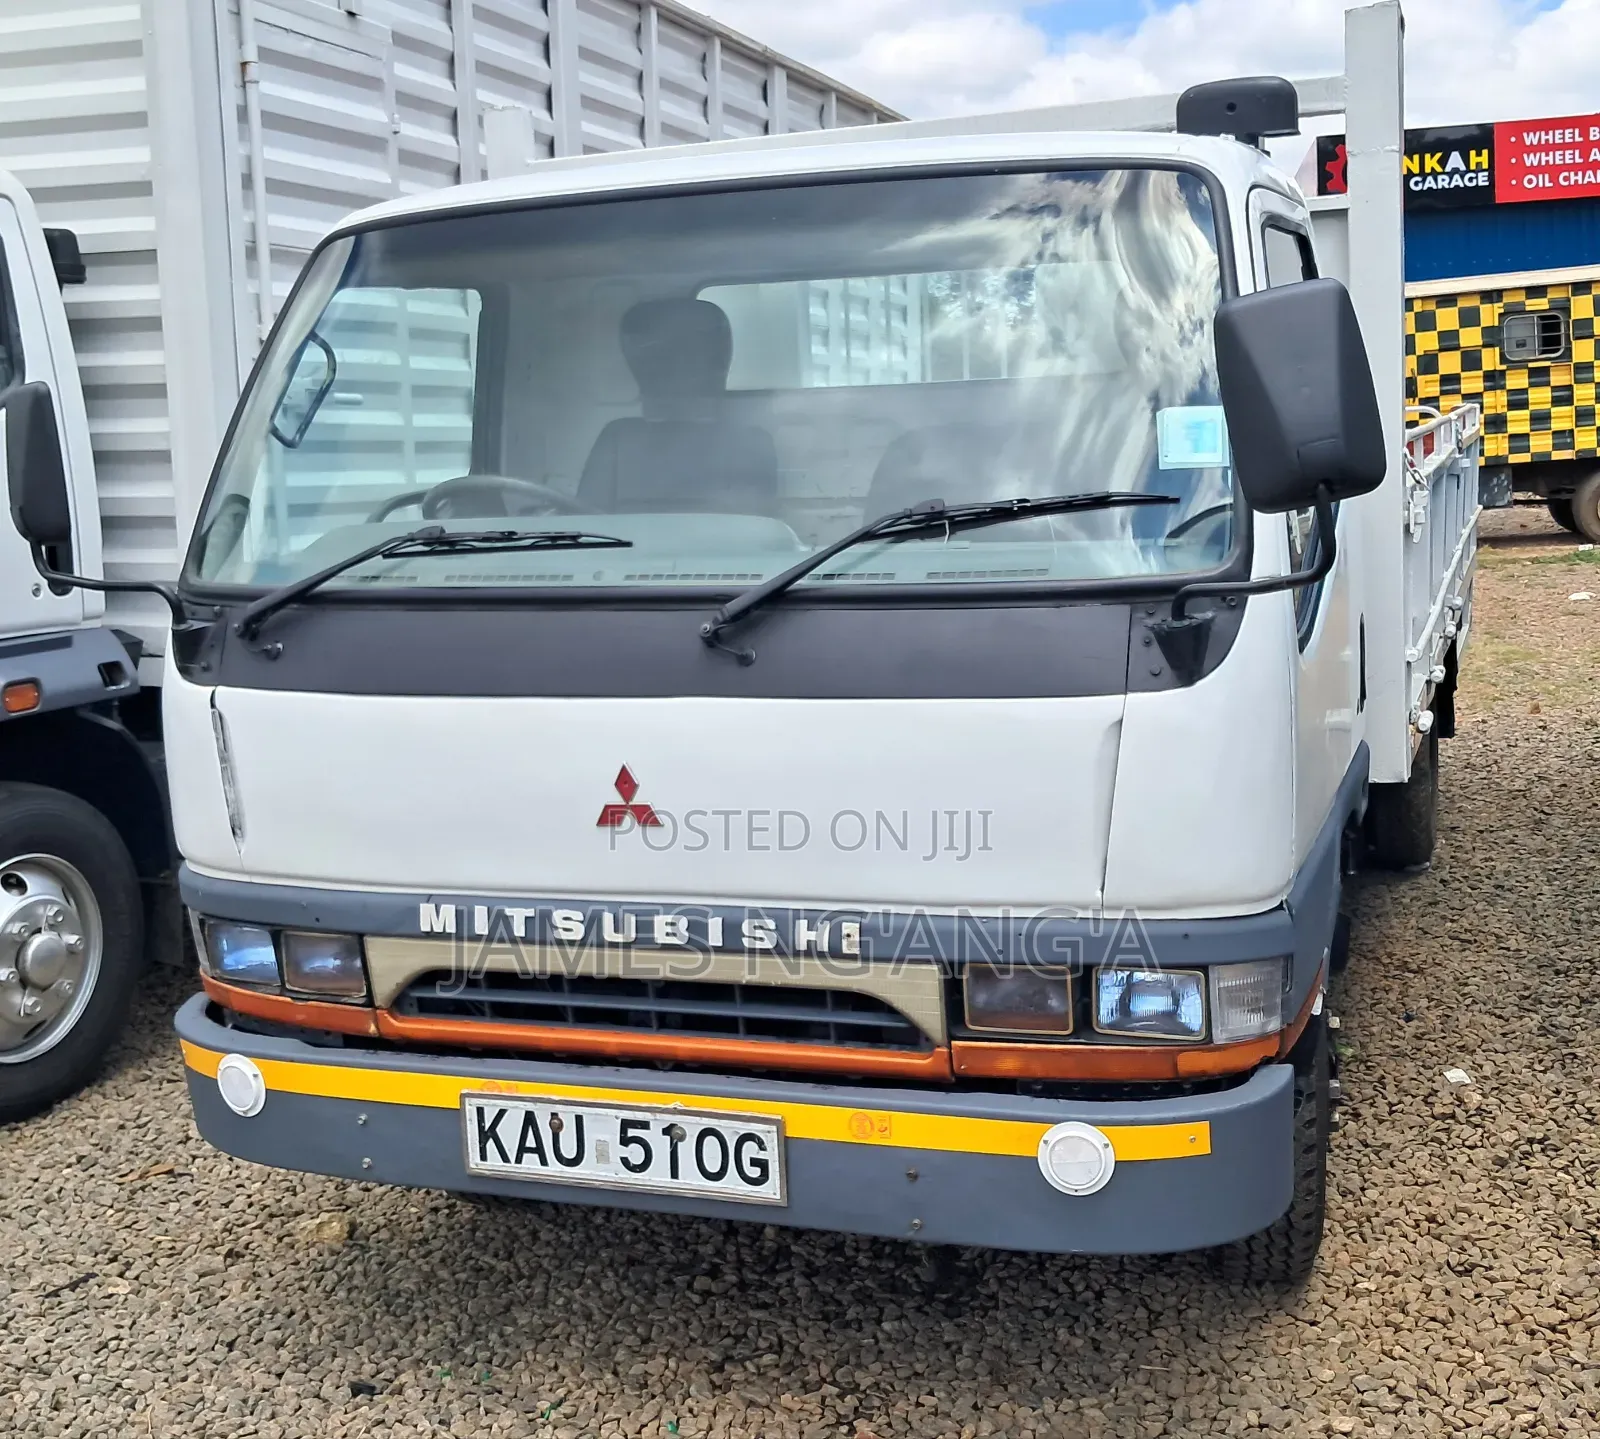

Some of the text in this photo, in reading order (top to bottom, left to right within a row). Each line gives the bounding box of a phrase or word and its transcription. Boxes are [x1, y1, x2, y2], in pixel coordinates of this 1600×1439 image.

[1522, 127, 1584, 146] WHEEL
[1522, 149, 1584, 167] WHEEL
[1409, 171, 1490, 192] GARAGE
[1522, 169, 1600, 189] OIL CHA
[419, 902, 862, 954] MITSUBISHI
[475, 1105, 586, 1169] KAU
[618, 1117, 771, 1187] 510G
